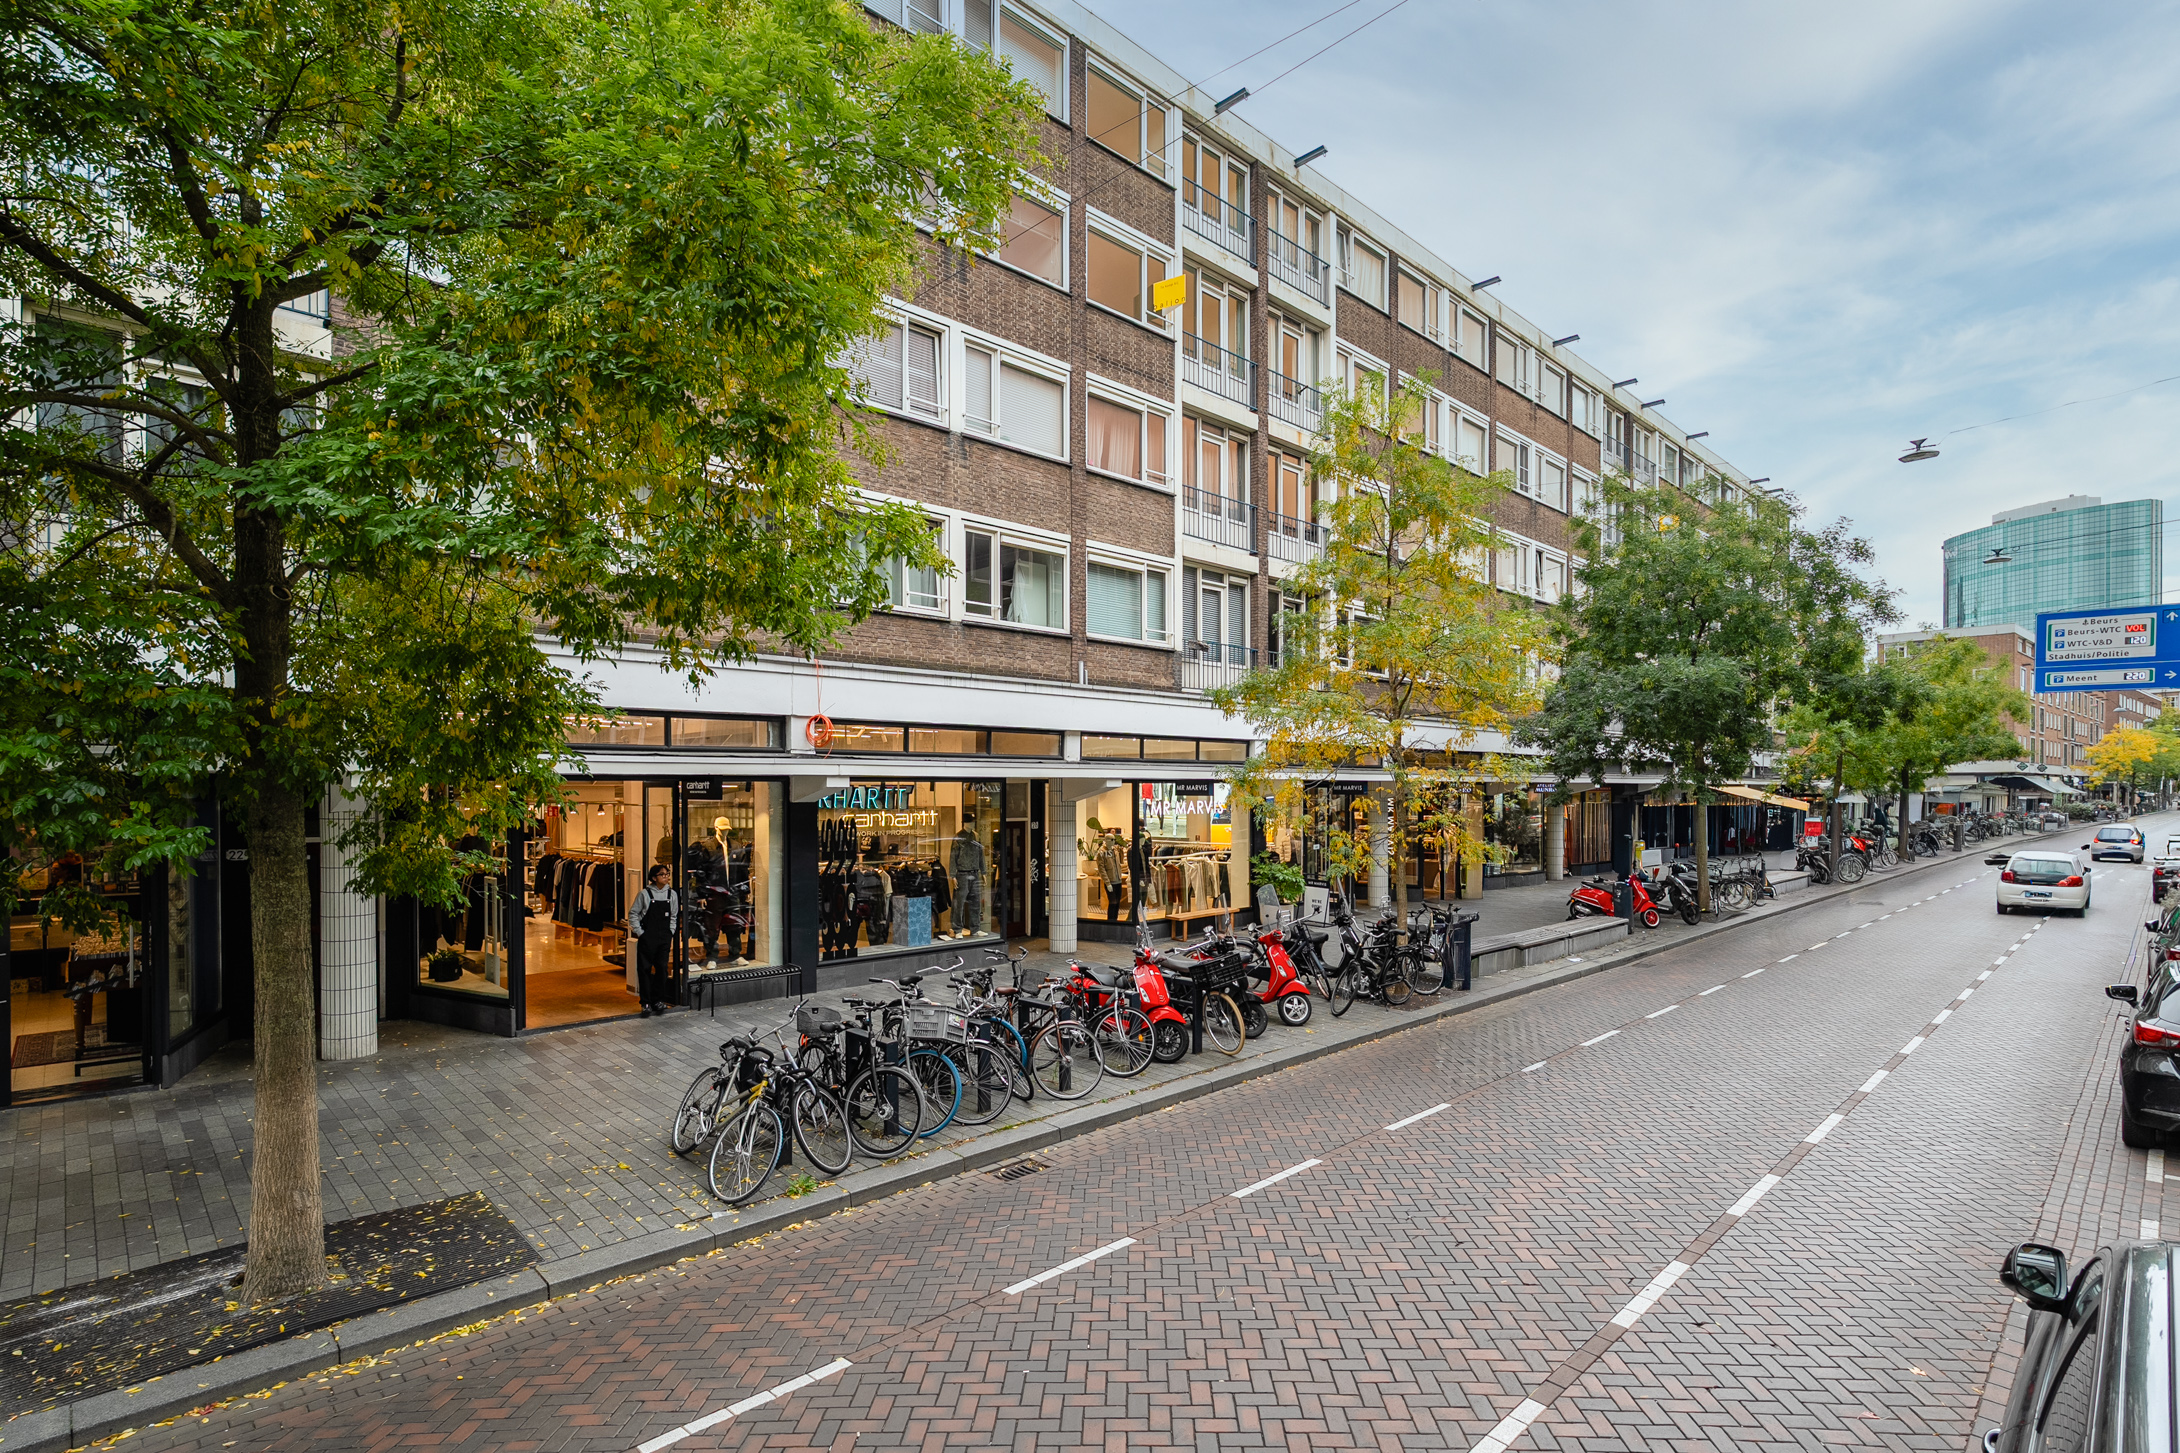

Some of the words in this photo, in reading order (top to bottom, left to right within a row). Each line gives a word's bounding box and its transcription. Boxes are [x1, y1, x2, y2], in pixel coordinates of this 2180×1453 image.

[2067, 626, 2121, 636] Beurs-WTC
[2125, 624, 2146, 632] VOL
[2067, 639, 2113, 647] WTC-V&D
[2130, 636, 2147, 644] 120
[2048, 650, 2130, 660] Stadhuis/Politie
[2126, 672, 2146, 680] 220
[686, 781, 710, 789] carhartt
[1151, 800, 1170, 816] MR
[1175, 800, 1224, 814] MARVIS
[842, 809, 938, 828] carhartt
